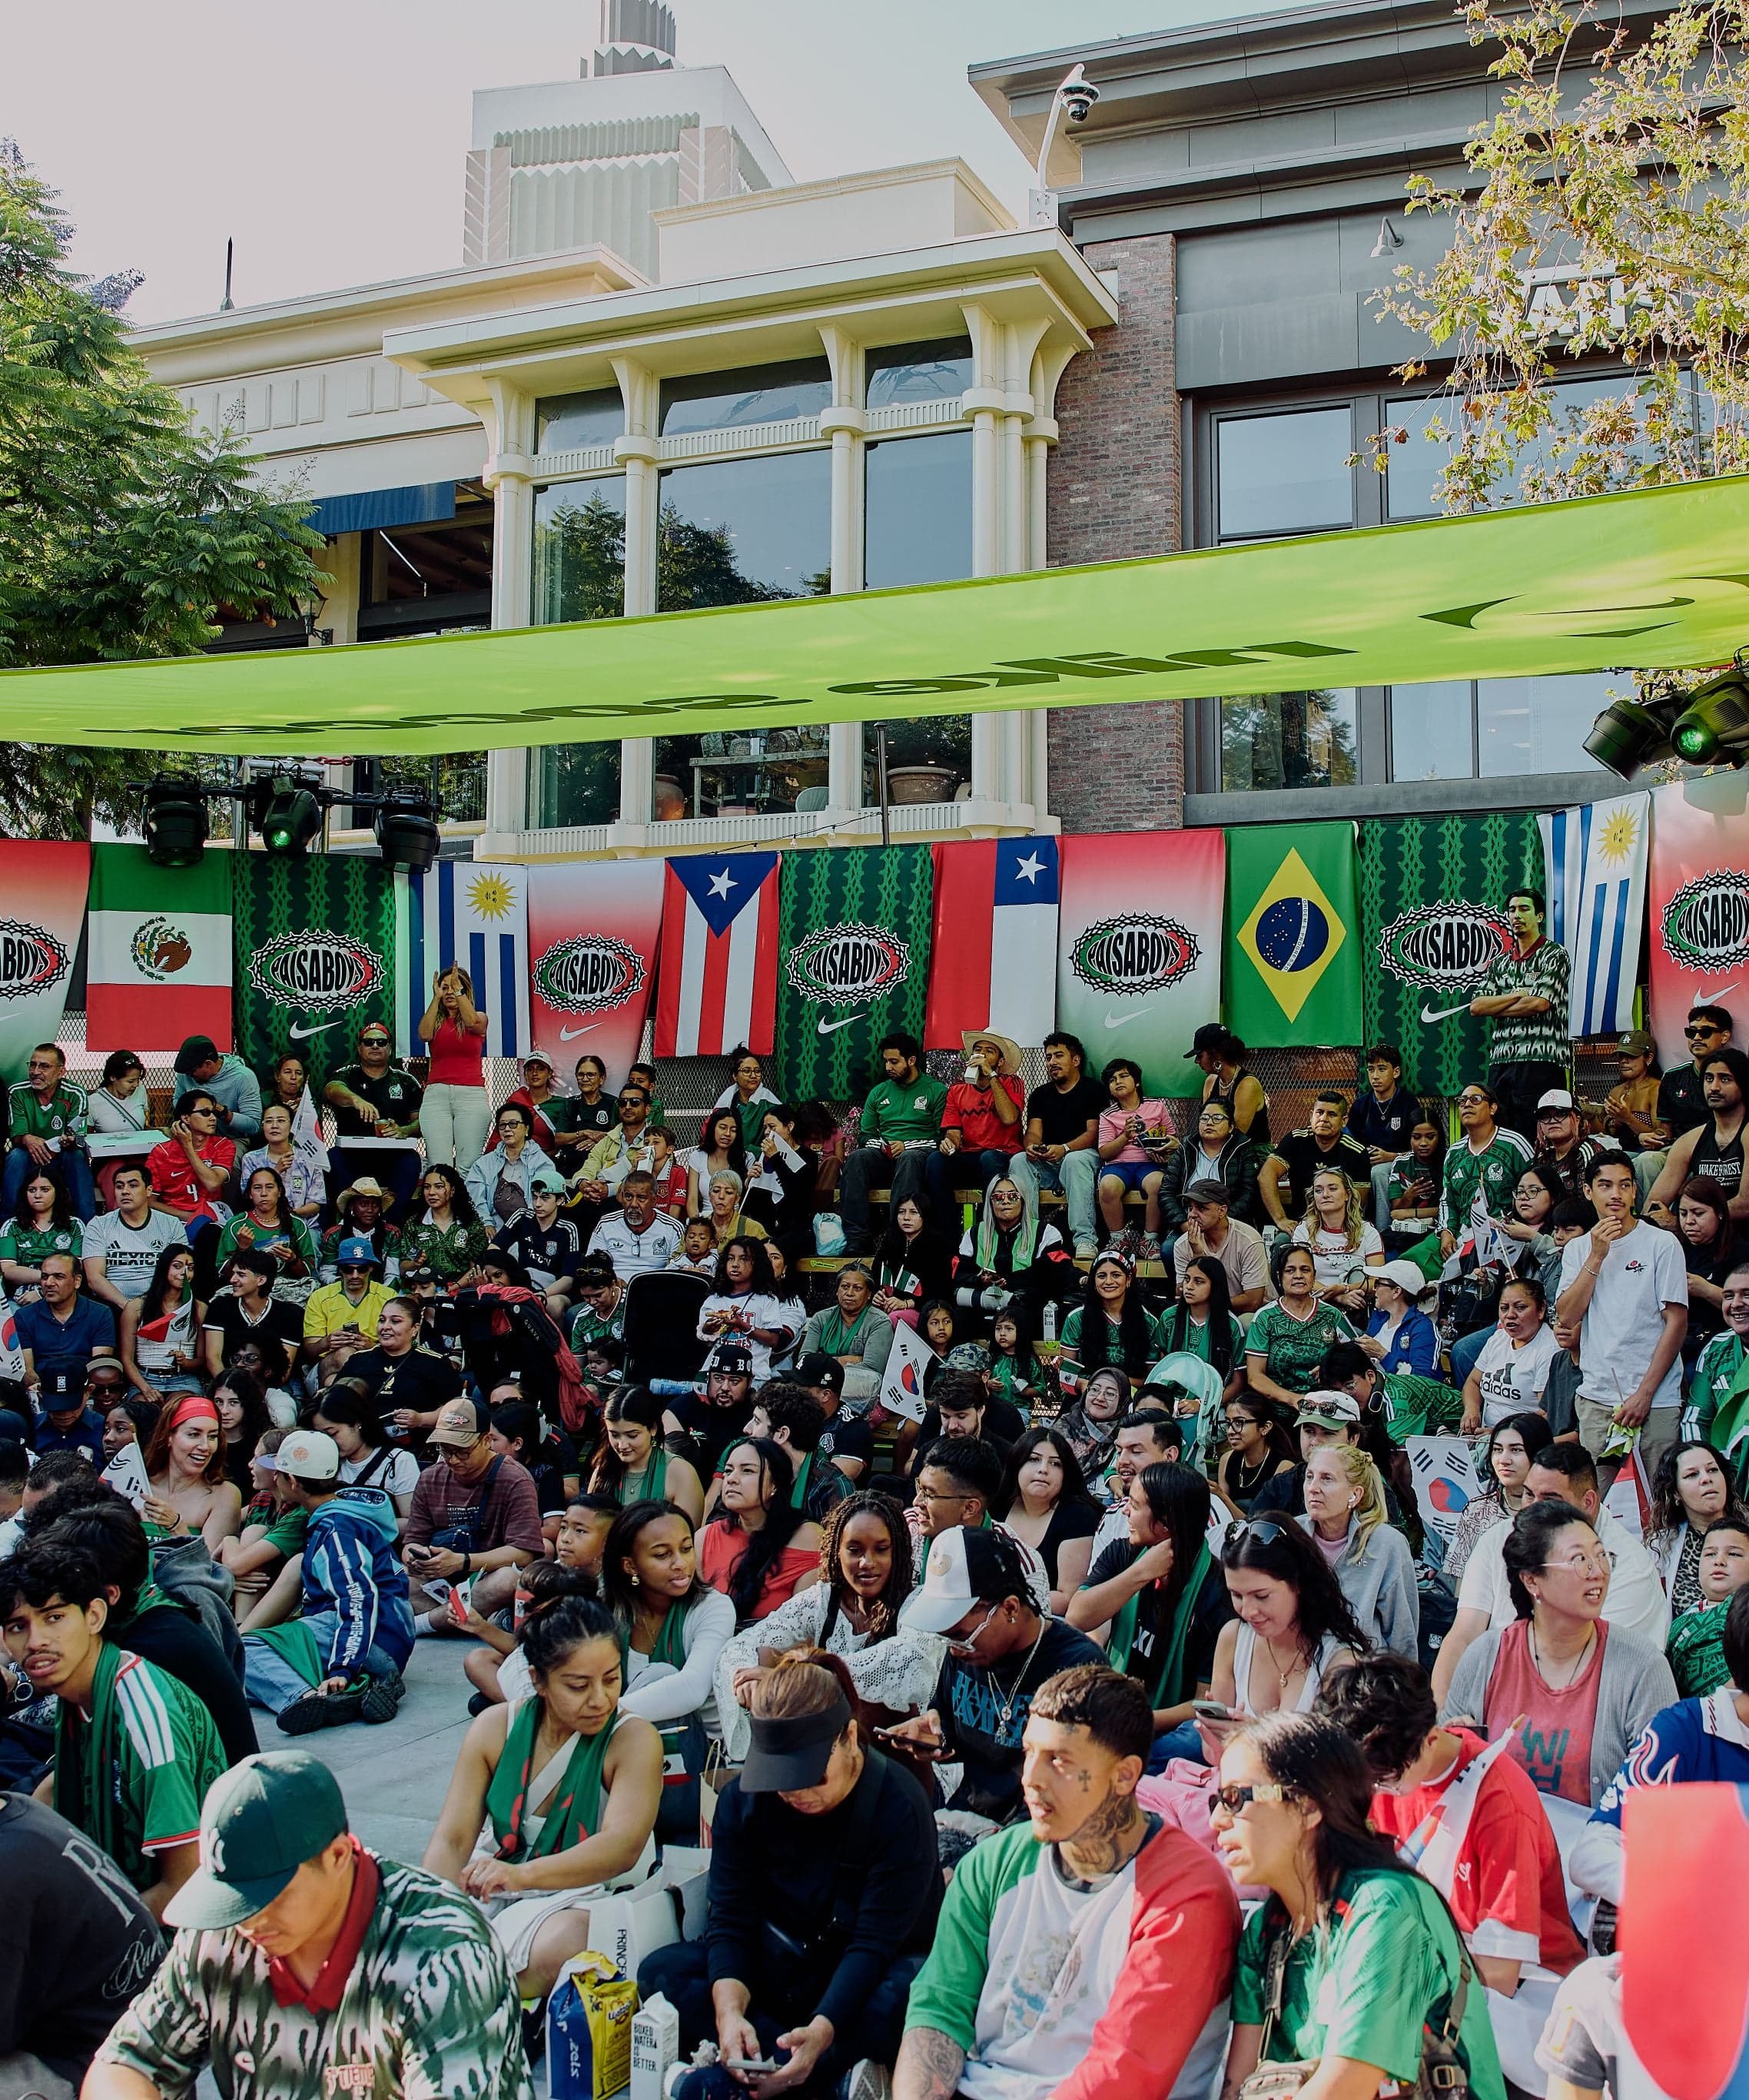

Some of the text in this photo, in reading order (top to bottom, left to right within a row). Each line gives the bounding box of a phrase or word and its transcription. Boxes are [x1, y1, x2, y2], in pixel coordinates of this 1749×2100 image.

[805, 942, 891, 986] PAISABOYS
[1087, 931, 1180, 977] PAISABOYS
[1401, 922, 1503, 970] PAISABOYS
[270, 949, 364, 992] PAISABOYS
[548, 952, 626, 995] PAISABOYS
[1698, 1161, 1741, 1176] WAKE FOREST
[186, 1184, 198, 1202] 4
[616, 1929, 627, 1979] PRINCE
[634, 2023, 653, 2037] BOXED
[634, 2037, 653, 2048] WATER
[633, 2048, 639, 2058] IS
